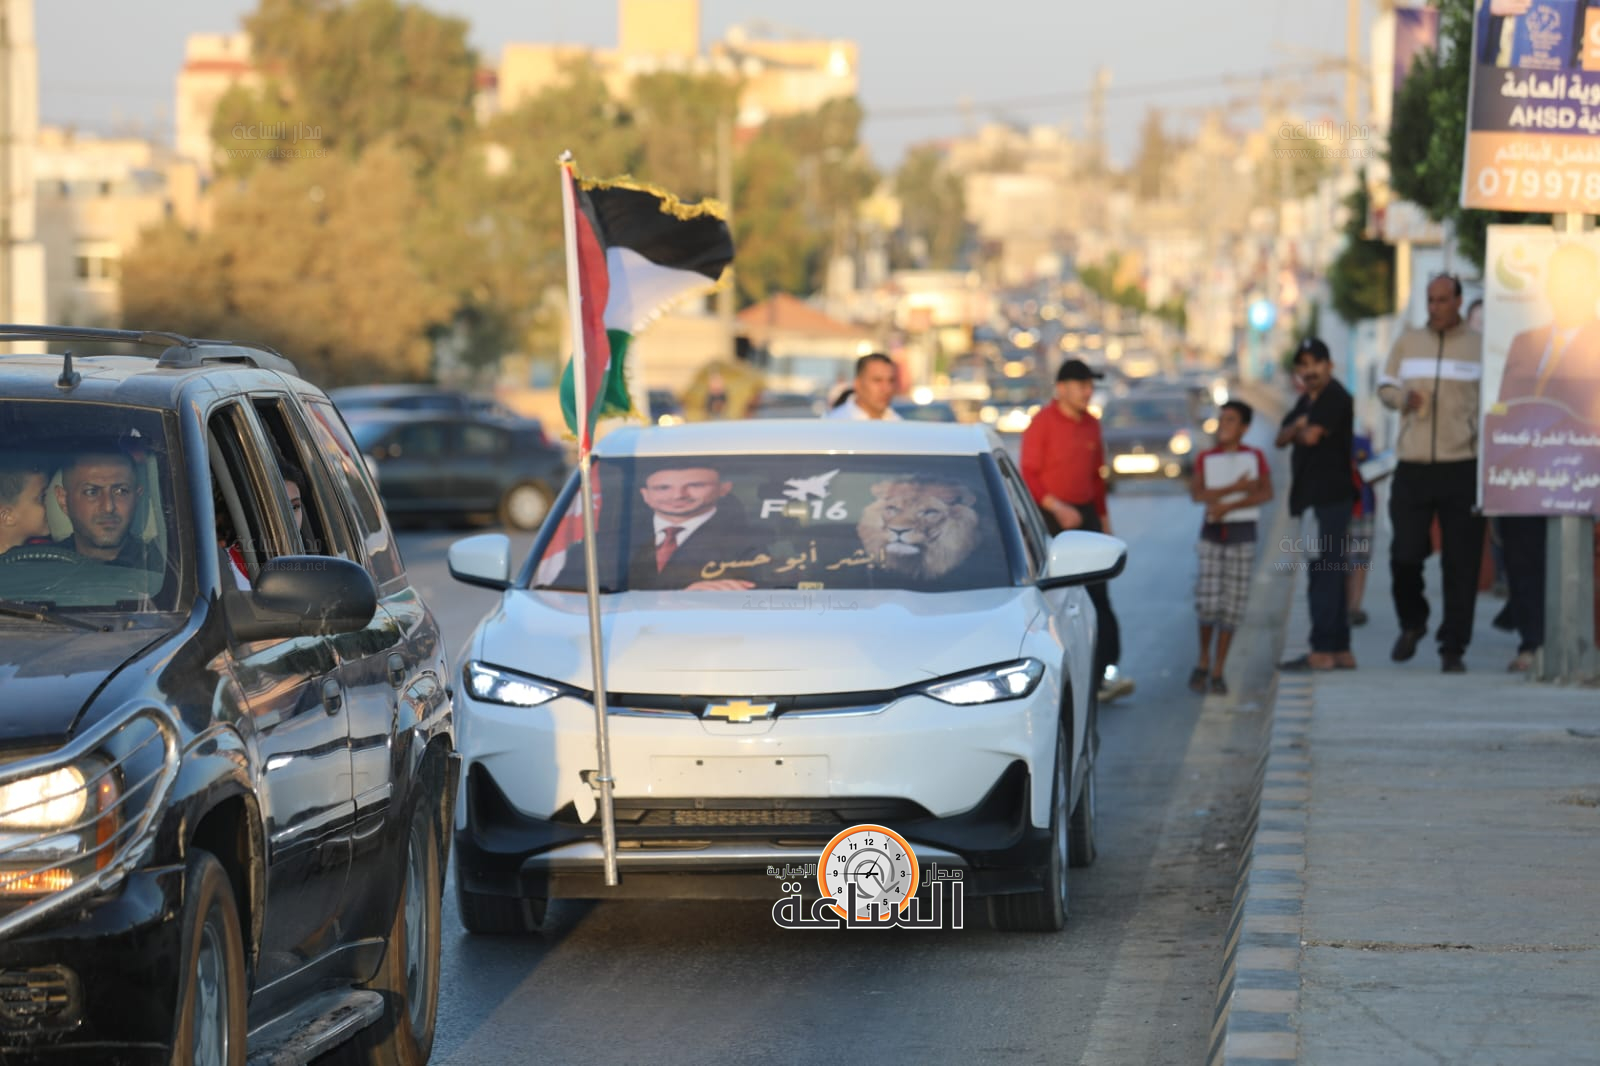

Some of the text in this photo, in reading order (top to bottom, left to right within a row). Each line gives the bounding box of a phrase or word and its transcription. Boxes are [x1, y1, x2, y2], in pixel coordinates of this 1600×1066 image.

[1501, 71, 1600, 106] وية العامة
[1508, 104, 1600, 134] ية AHSD
[1478, 167, 1600, 200] 079978
[700, 553, 772, 579] حسن
[774, 539, 818, 573] أبو
